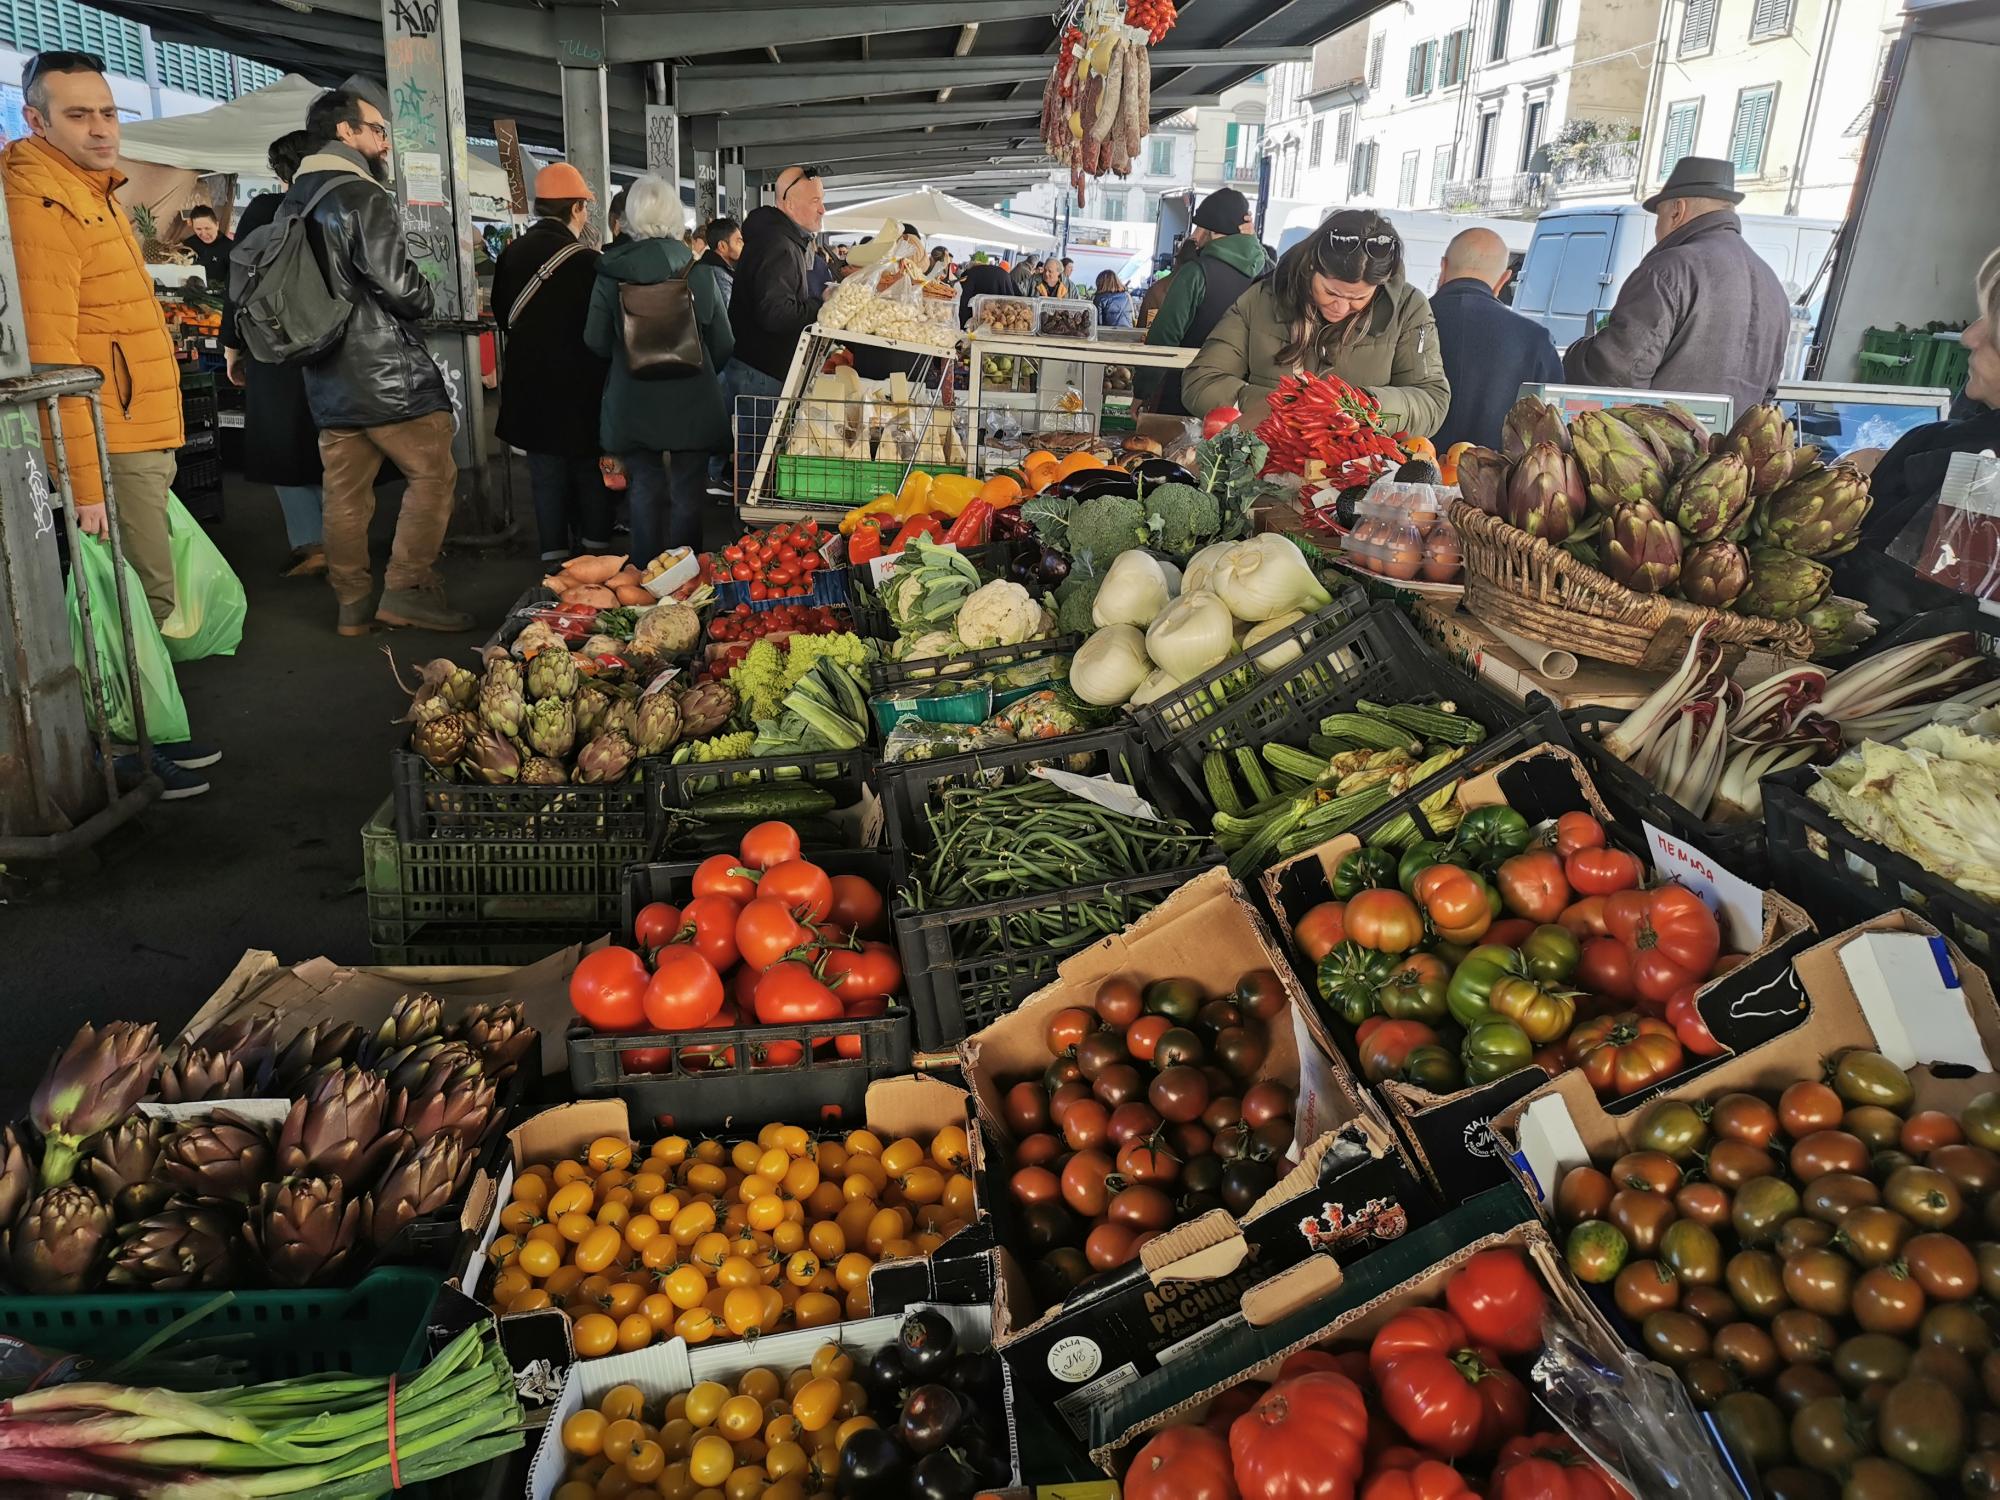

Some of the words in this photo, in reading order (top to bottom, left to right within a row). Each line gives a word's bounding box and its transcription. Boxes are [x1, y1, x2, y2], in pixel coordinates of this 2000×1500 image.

[1463, 1115, 1490, 1135] ITALI
[1052, 1339, 1080, 1357] ITALIA
[1085, 1383, 1104, 1396] ITALIA
[1106, 1370, 1126, 1384] SICILIA
